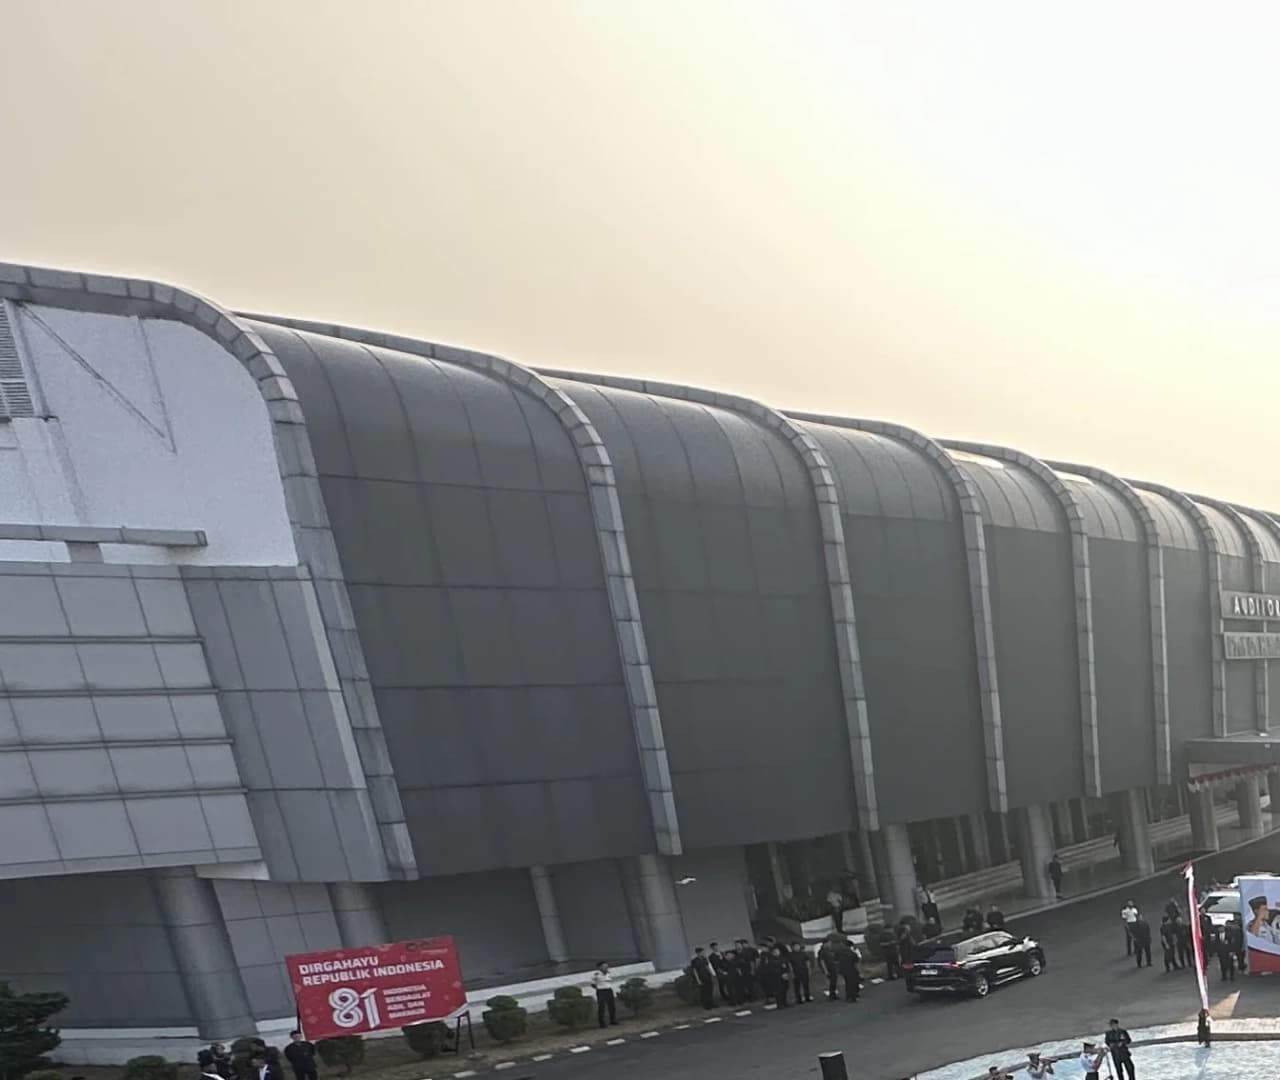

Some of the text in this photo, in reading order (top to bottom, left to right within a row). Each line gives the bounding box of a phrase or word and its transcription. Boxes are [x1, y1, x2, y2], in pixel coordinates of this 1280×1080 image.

[299, 956, 379, 975] DIRGAHAYU
[303, 960, 444, 986] REPUBLIK INDONESIA
[329, 988, 380, 1029] 81
